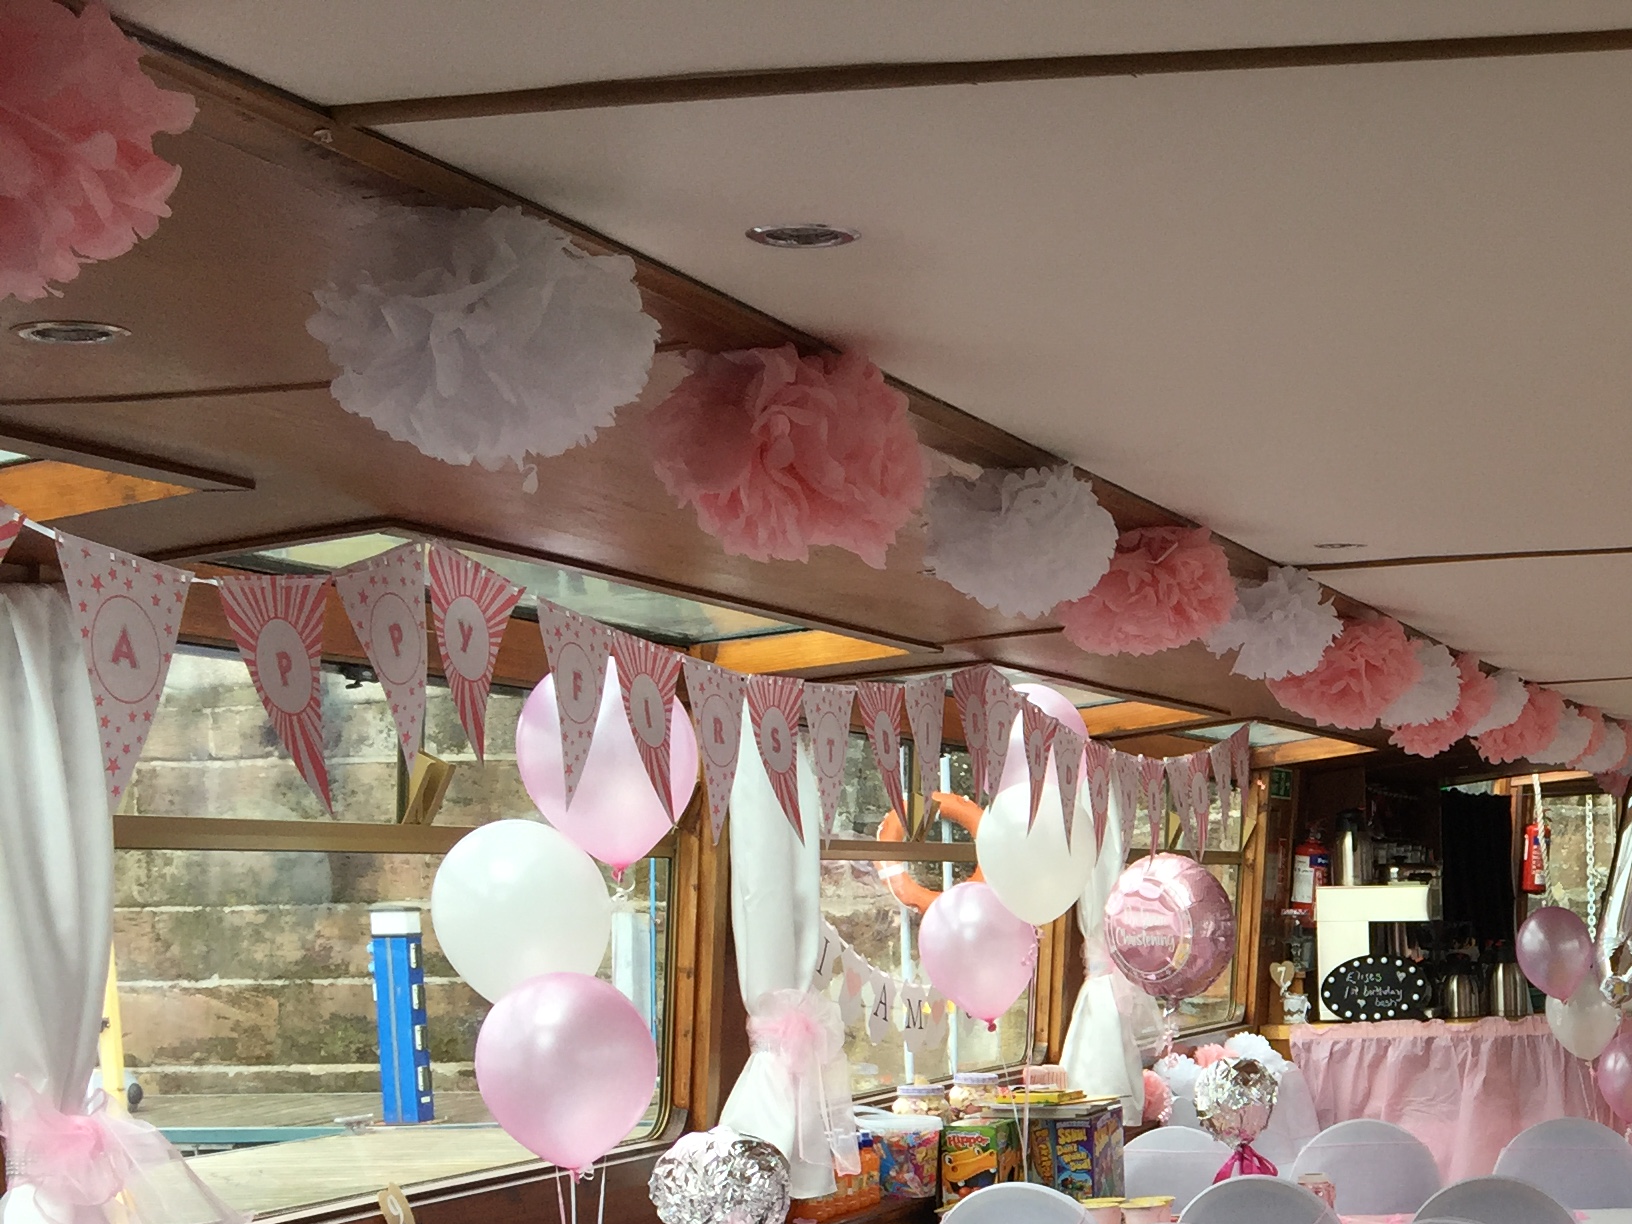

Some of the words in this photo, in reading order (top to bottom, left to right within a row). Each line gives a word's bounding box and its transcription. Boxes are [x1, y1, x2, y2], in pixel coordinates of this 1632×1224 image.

[111, 619, 474, 688] APPY
[572, 670, 836, 763] FIRST
[1277, 966, 1286, 983] 7
[1363, 984, 1403, 1003] birthday
[1375, 997, 1398, 1008] bash
[873, 983, 925, 1030] AM
